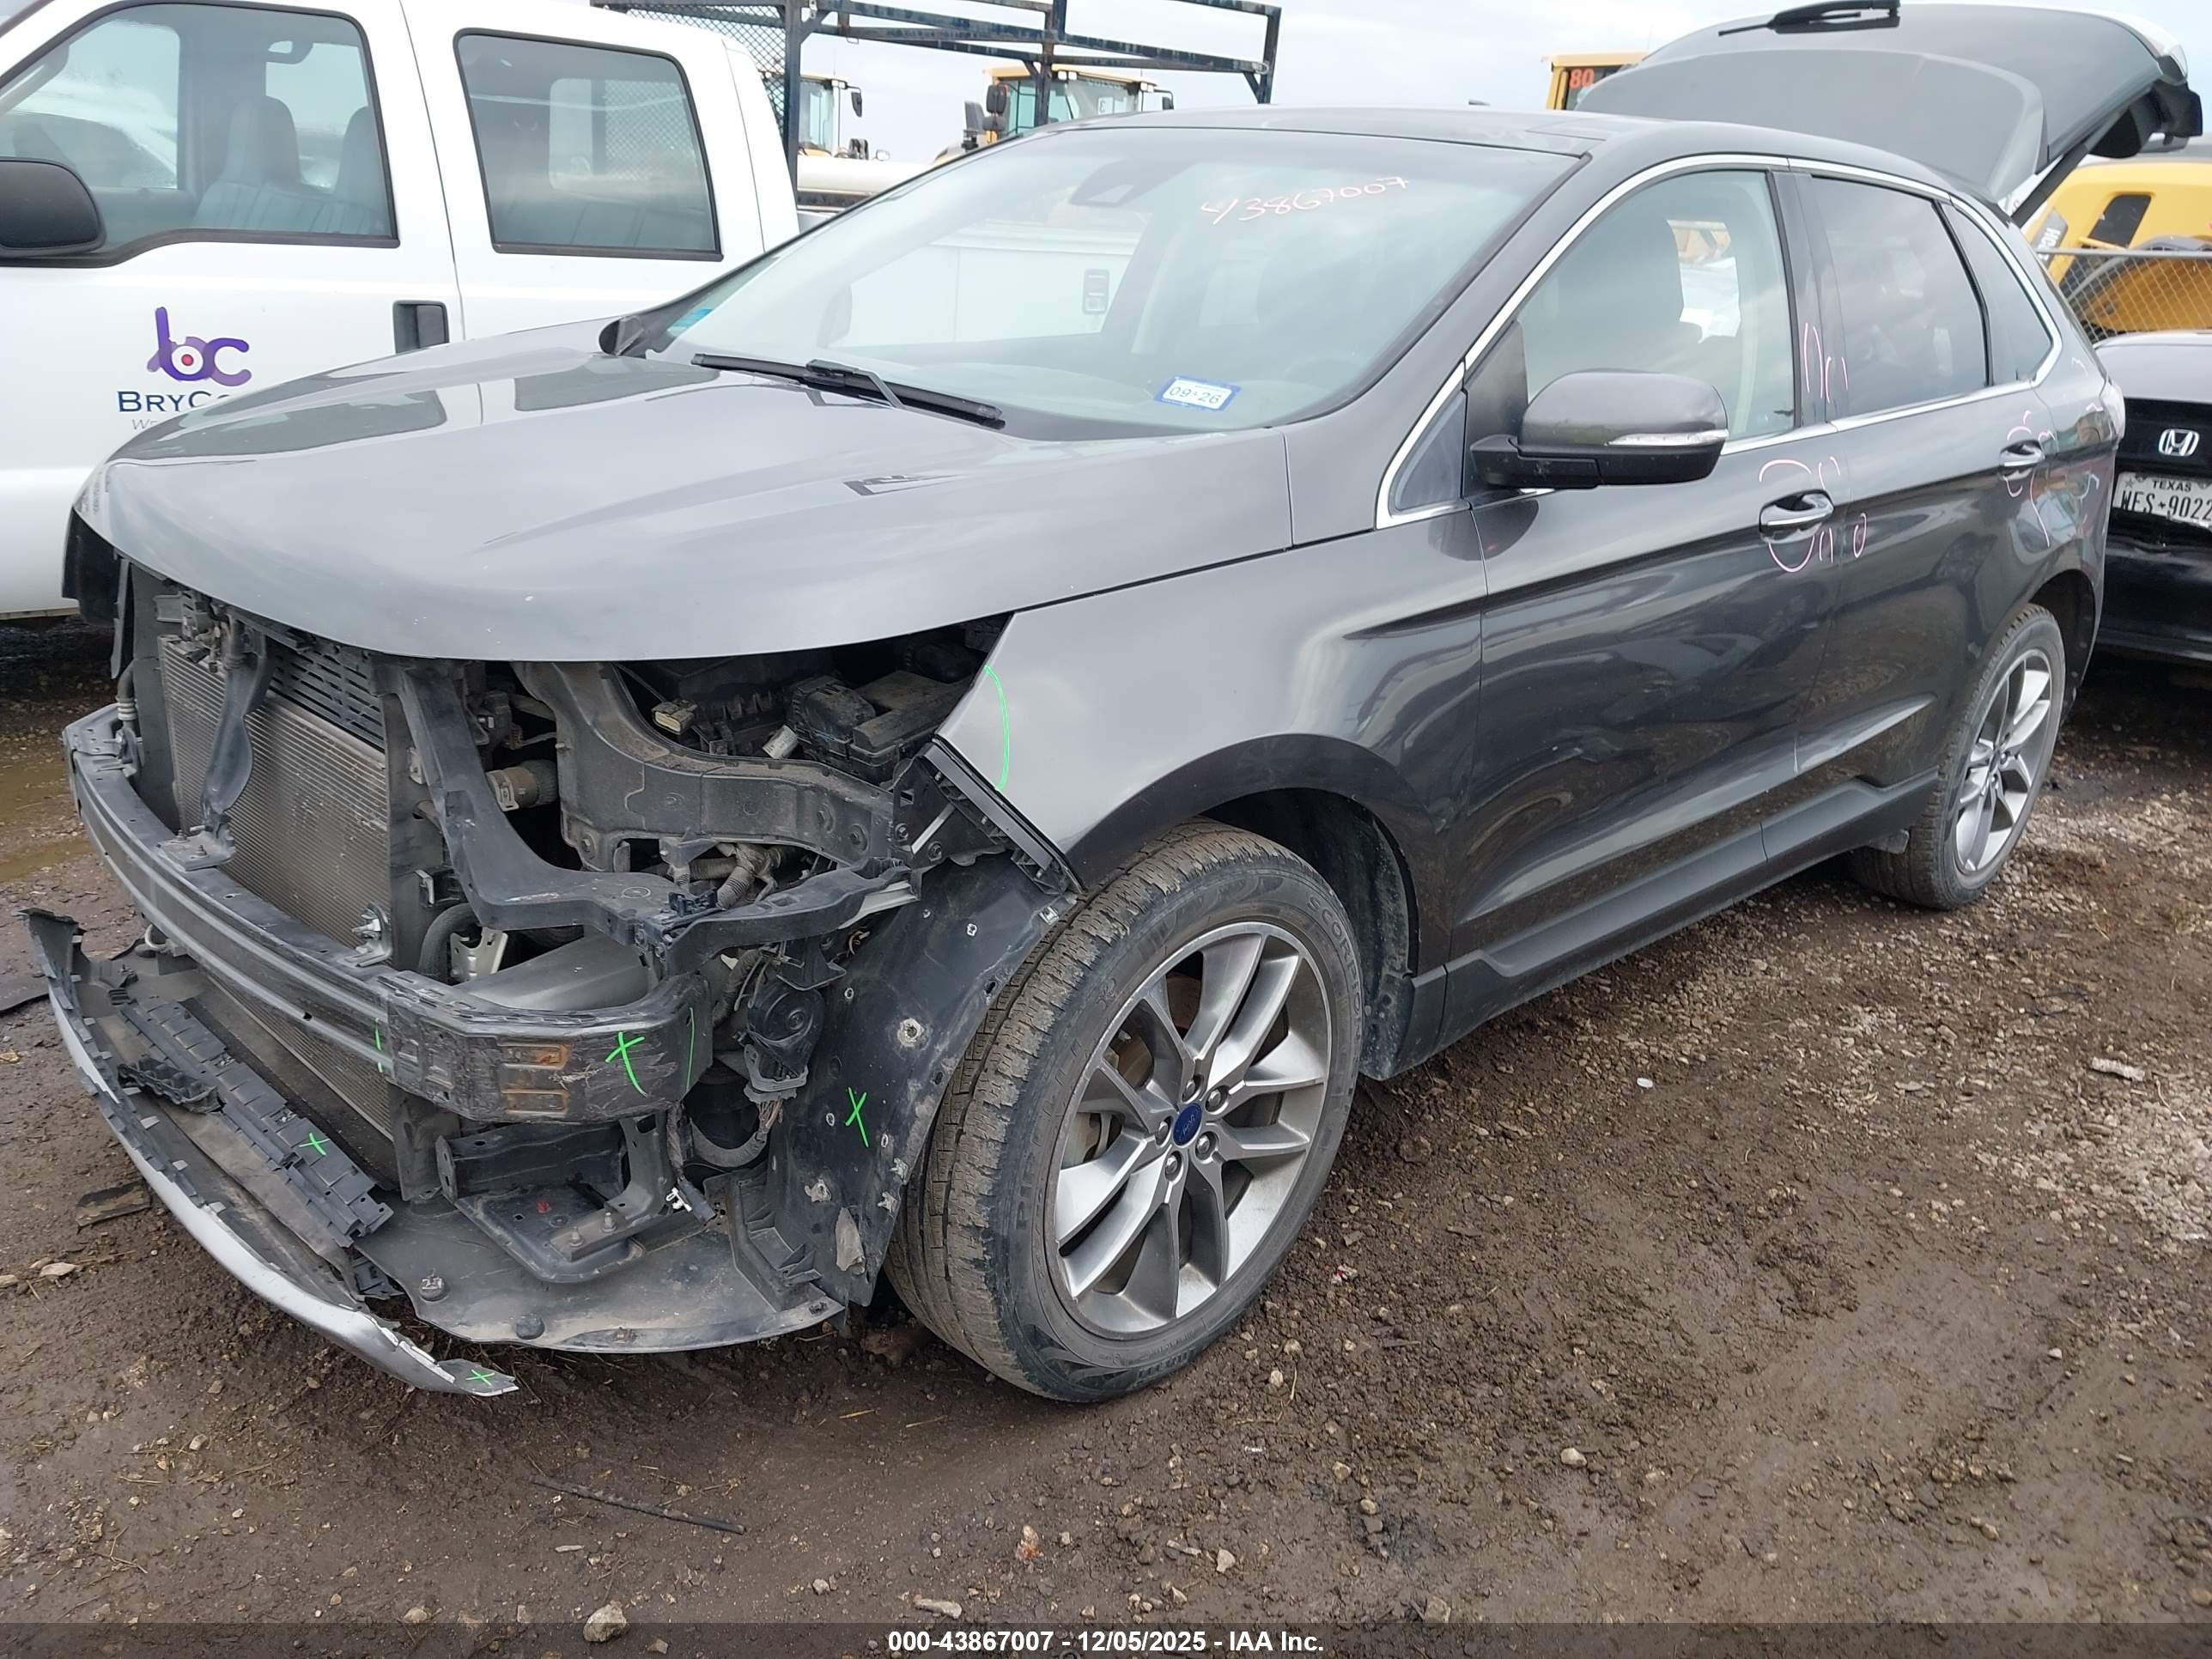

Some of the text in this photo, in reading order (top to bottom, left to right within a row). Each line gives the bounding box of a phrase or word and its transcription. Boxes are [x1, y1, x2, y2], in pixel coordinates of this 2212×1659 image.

[1570, 69, 1595, 90] 80
[117, 391, 230, 412] BRYC
[2153, 480, 2191, 492] TEXAS
